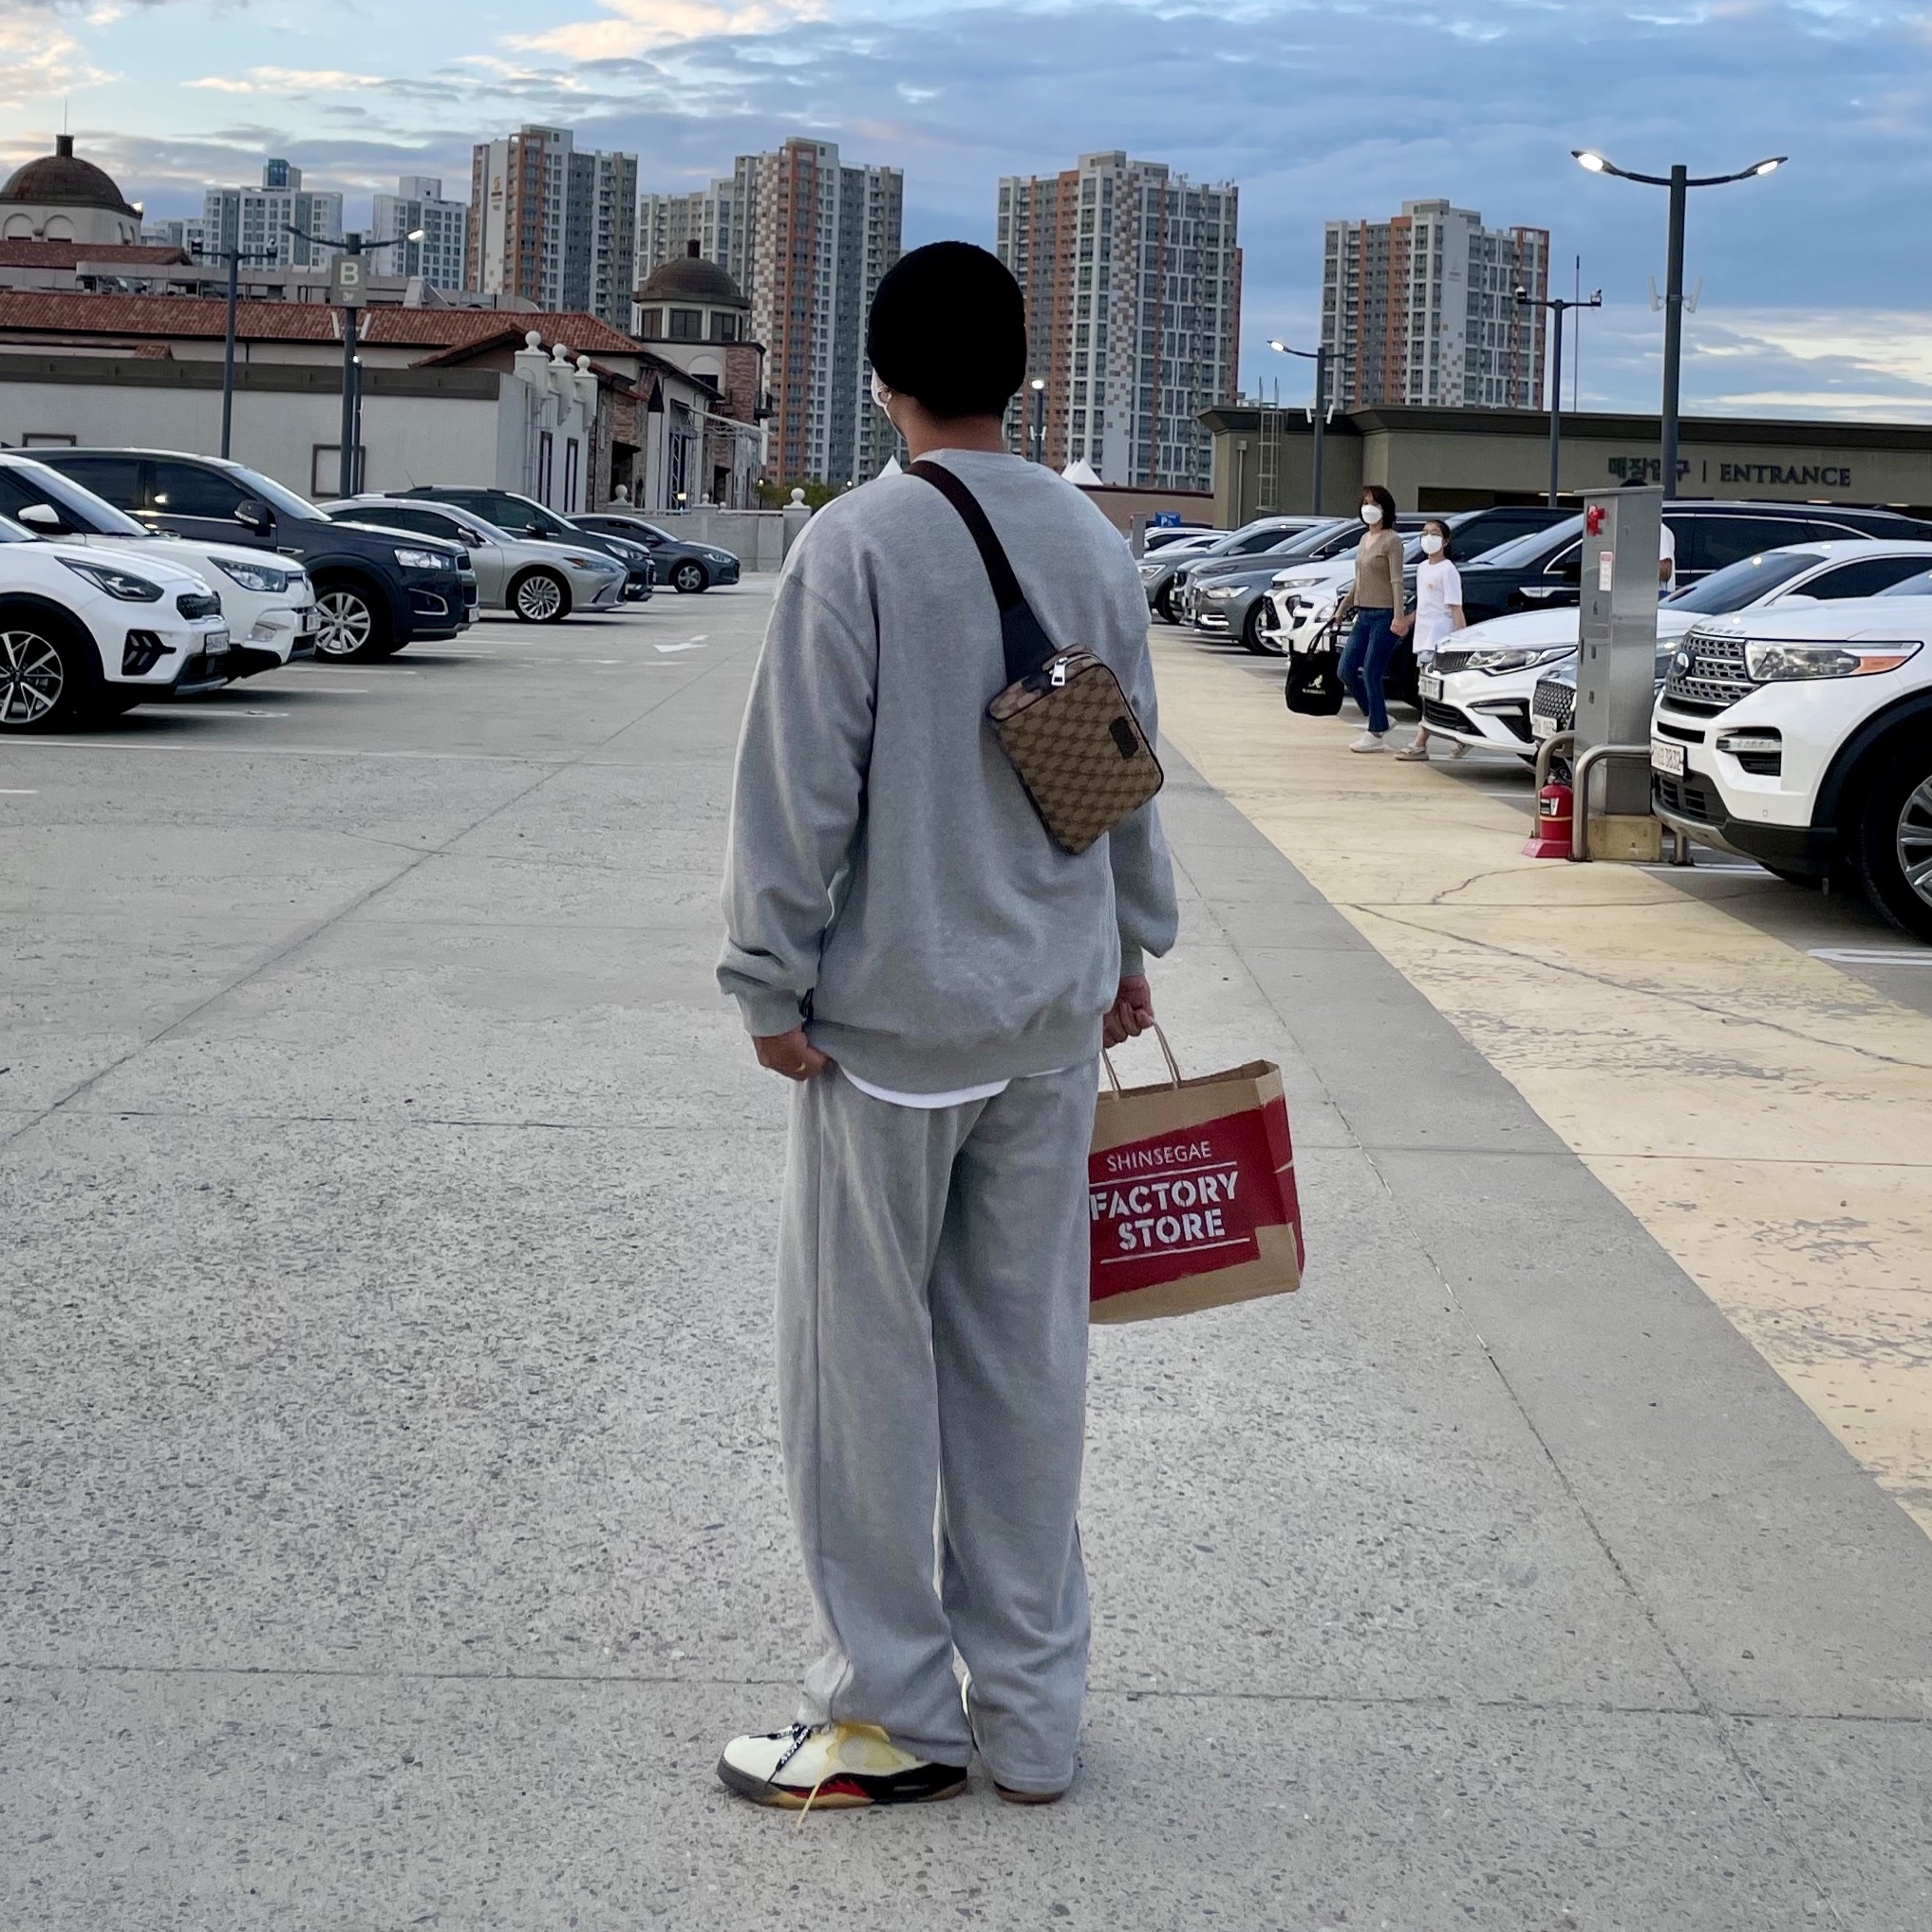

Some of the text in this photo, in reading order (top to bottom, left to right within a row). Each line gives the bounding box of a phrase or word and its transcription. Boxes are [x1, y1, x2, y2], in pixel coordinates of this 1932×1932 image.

[341, 262, 359, 285] B
[1719, 463, 1850, 487] ENTRANCE
[1107, 1140, 1212, 1172] SHINSEGAE
[1090, 1171, 1239, 1221] FACTORY
[1117, 1208, 1226, 1250] STORE
